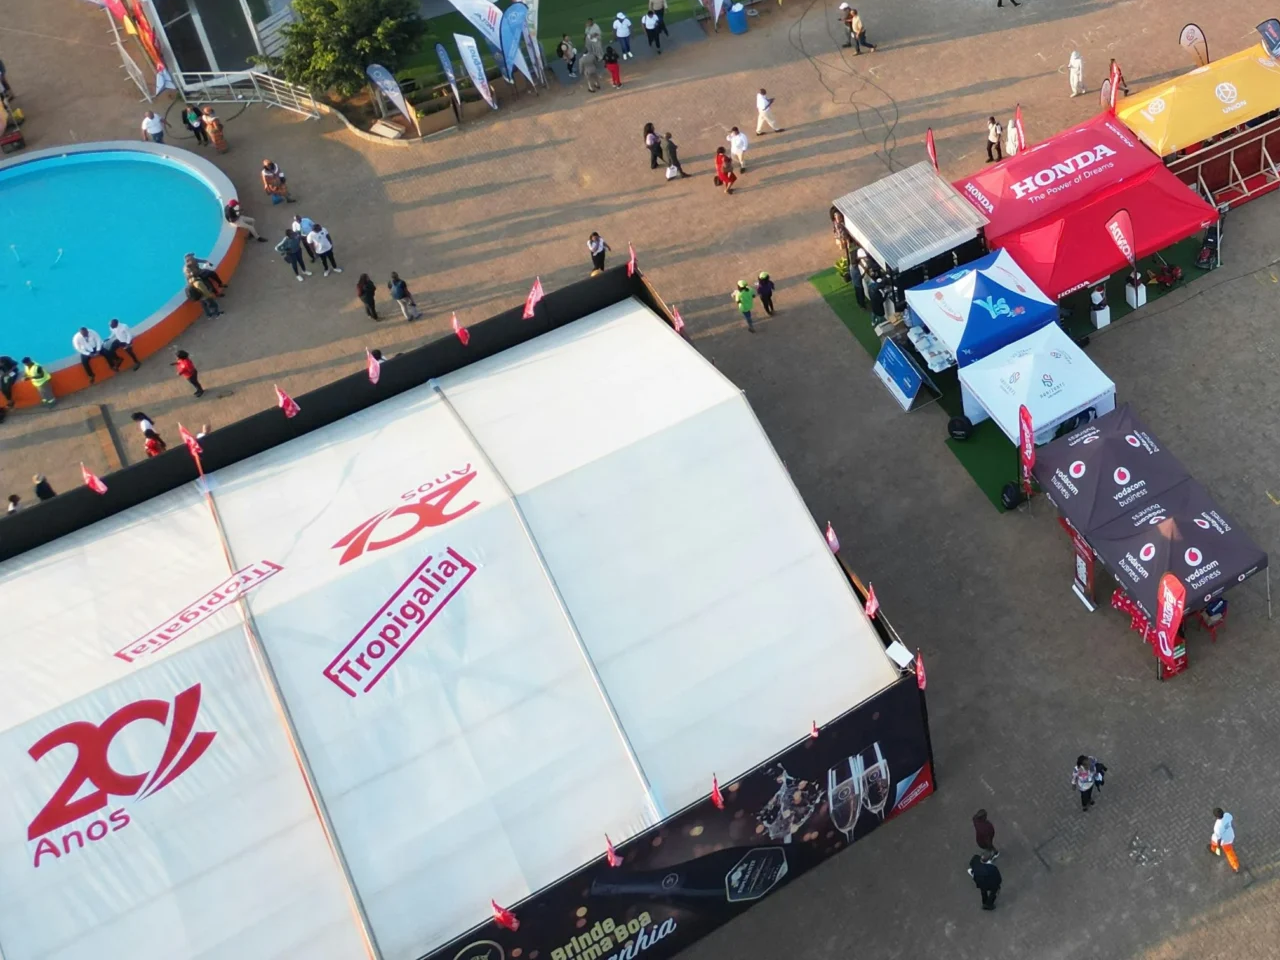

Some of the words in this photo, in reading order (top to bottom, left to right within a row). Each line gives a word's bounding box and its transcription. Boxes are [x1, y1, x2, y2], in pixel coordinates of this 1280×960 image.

[1222, 99, 1247, 114] UNION
[1105, 121, 1135, 148] HONDA
[1010, 143, 1117, 199] HONDA
[1028, 192, 1046, 205] The
[1047, 180, 1073, 196] Power
[1073, 174, 1083, 184] of
[1083, 161, 1115, 178] Dreams
[964, 182, 995, 214] HONDA
[1057, 280, 1091, 299] HONDA
[400, 463, 472, 503] Anos
[1051, 475, 1071, 500] business
[1055, 468, 1079, 496] vodacom
[1113, 480, 1146, 501] vodacom
[1118, 488, 1148, 508] business
[1118, 558, 1141, 583] business
[1125, 551, 1149, 579] vodacom
[1184, 559, 1220, 583] vodacom
[1190, 569, 1222, 590] business
[131, 561, 279, 659] Tropigalia
[338, 555, 459, 686] Tropigalia
[33, 806, 131, 868] Anos
[550, 916, 616, 960] Brinde
[613, 910, 652, 939] Boa
